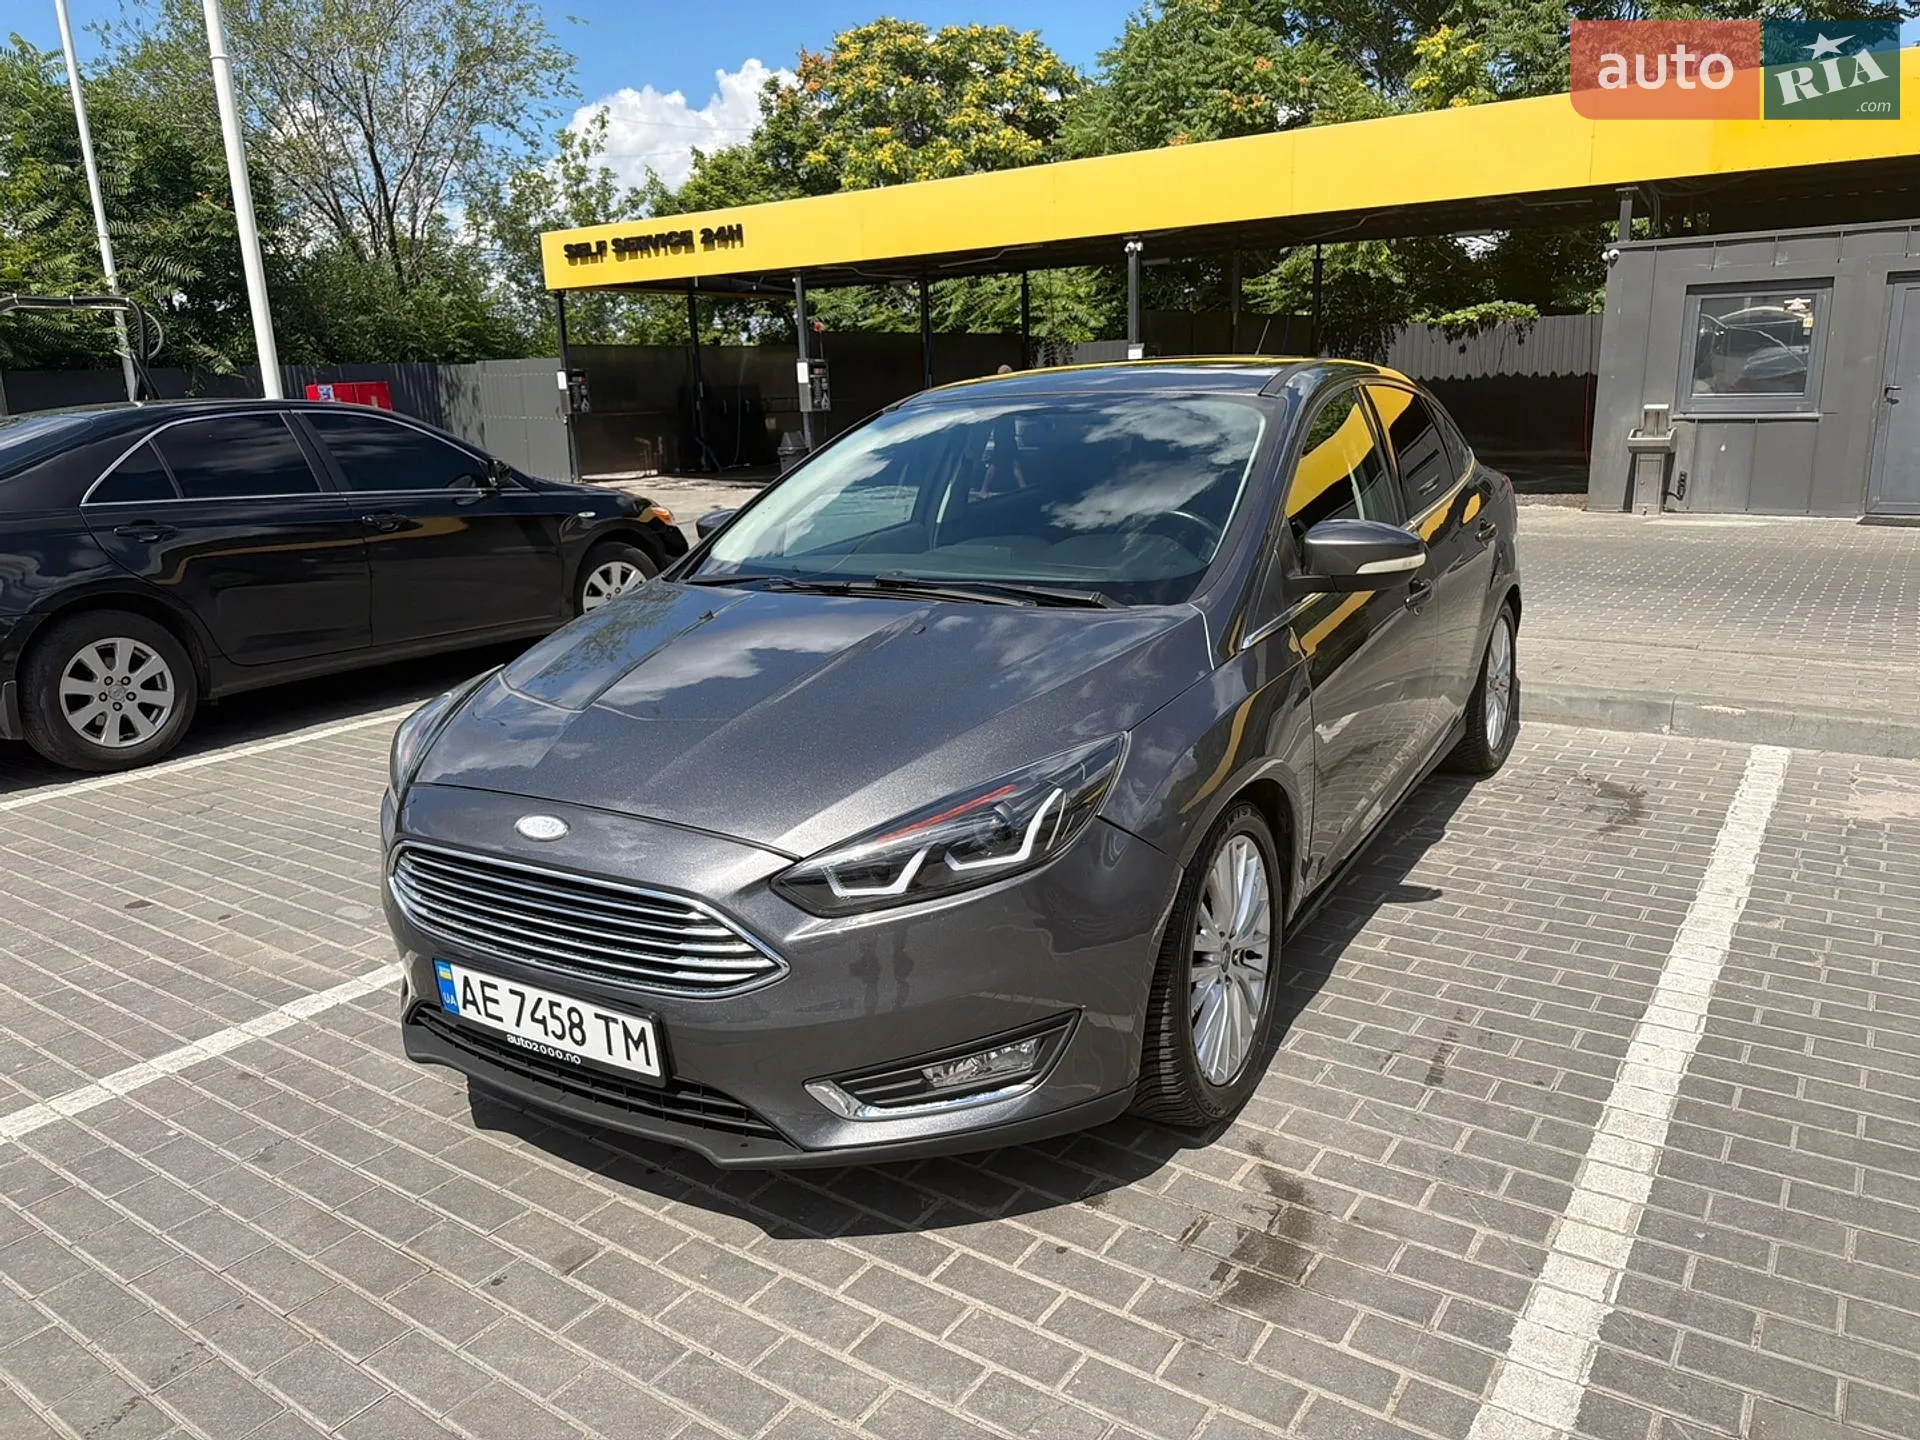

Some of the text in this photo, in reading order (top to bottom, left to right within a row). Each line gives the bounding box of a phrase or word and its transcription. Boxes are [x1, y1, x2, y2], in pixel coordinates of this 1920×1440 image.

[563, 224, 743, 263] SELF SERVICE 24H
[442, 992, 457, 1007] UA
[461, 974, 652, 1067] AE 7458 TM
[506, 1033, 582, 1066] auto2000.no
